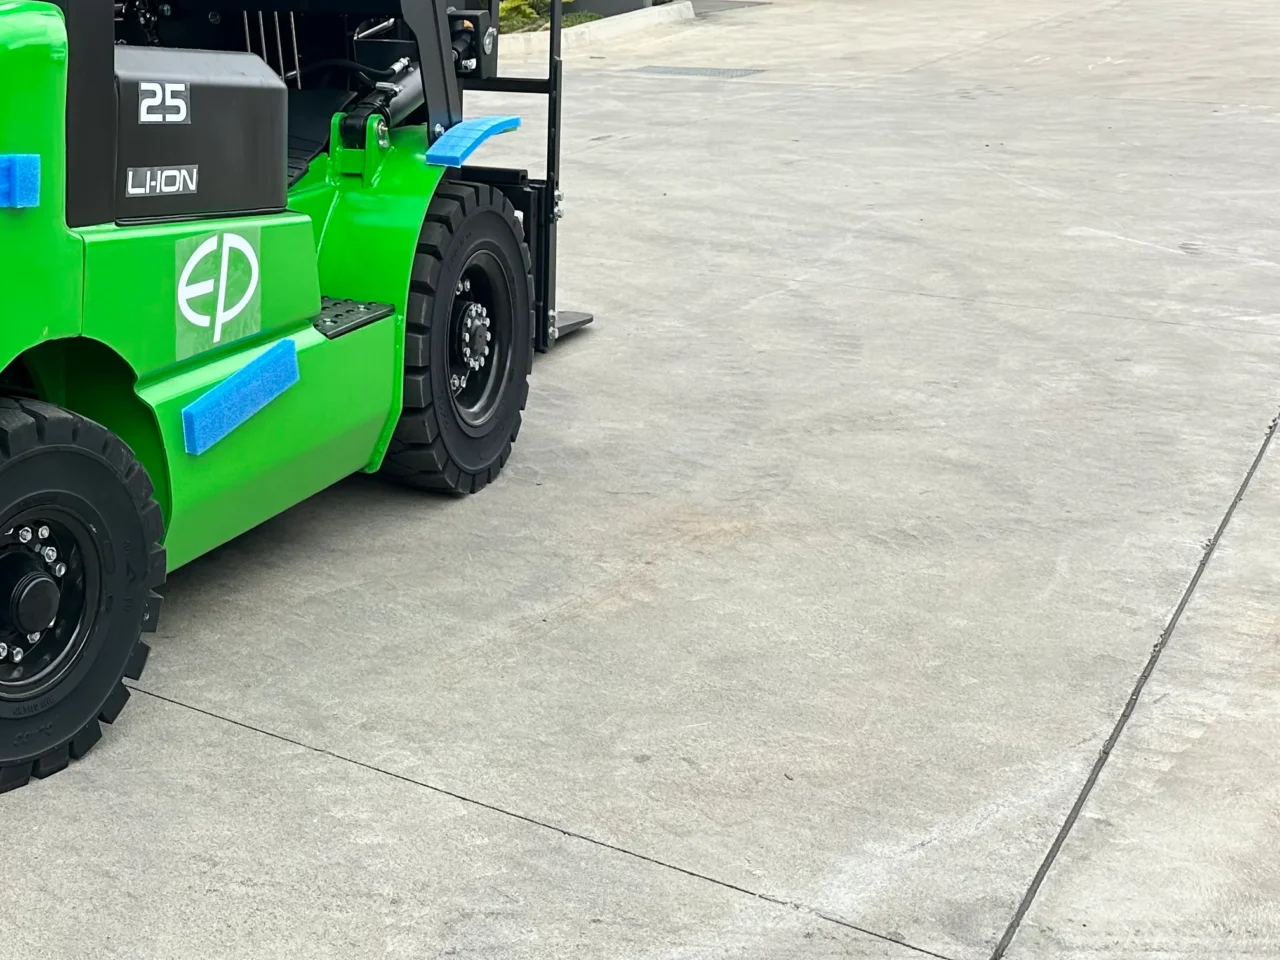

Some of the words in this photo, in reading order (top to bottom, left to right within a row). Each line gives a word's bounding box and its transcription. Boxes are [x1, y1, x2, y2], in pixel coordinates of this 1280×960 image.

[140, 82, 187, 122] 25
[127, 168, 197, 194] LI-ION
[177, 232, 259, 344] EP
